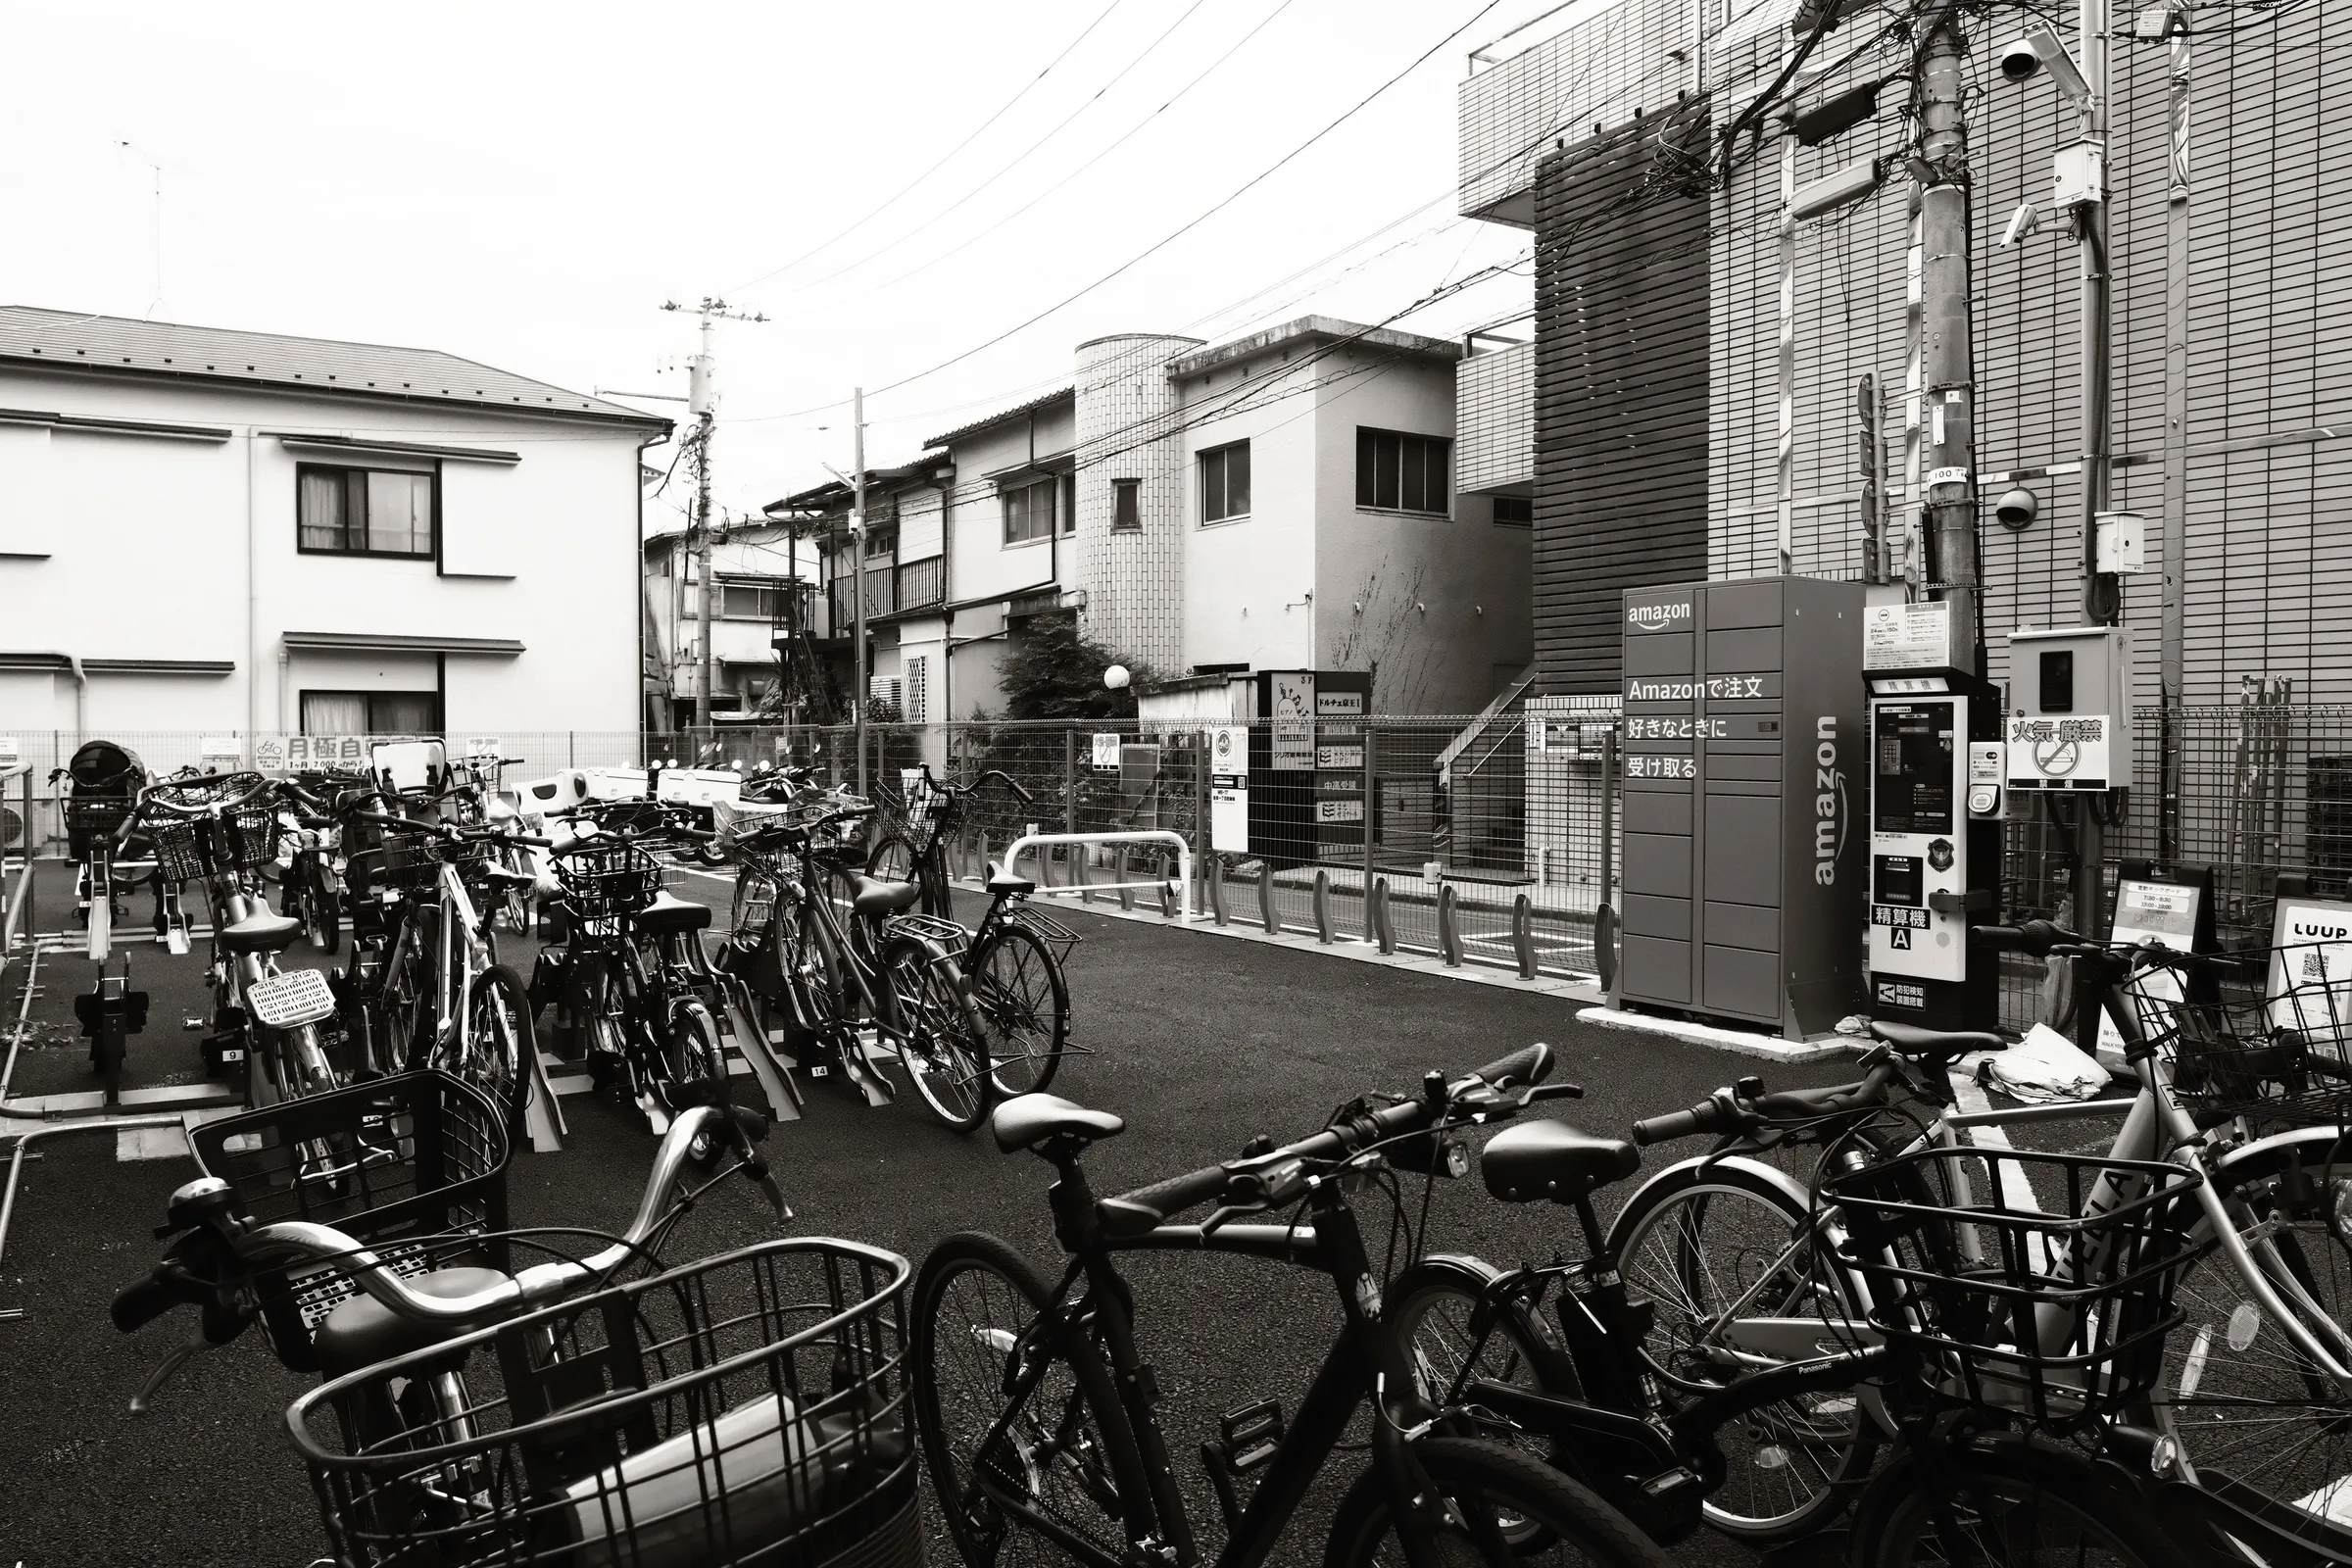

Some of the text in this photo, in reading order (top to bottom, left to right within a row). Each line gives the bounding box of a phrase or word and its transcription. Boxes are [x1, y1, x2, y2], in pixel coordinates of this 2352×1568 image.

[1629, 603, 1690, 622] amazon
[1629, 676, 1763, 700] Amazonで注文
[1887, 680, 1933, 692] 精算機
[1628, 718, 1728, 739] 好きなときに
[2012, 719, 2102, 743] 火気厳禁
[1628, 757, 1696, 778] 受け取る
[2039, 779, 2074, 788] 禁煙
[1815, 716, 1837, 886] amazon
[1876, 906, 1926, 928] 精算機
[1892, 929, 1909, 949] A
[2294, 923, 2348, 940] LUUP
[1896, 984, 1924, 997] 防犯検知
[1896, 995, 1924, 1007] 装置搭載
[229, 1052, 236, 1060] 9
[1798, 1361, 1833, 1375] Panasonic
